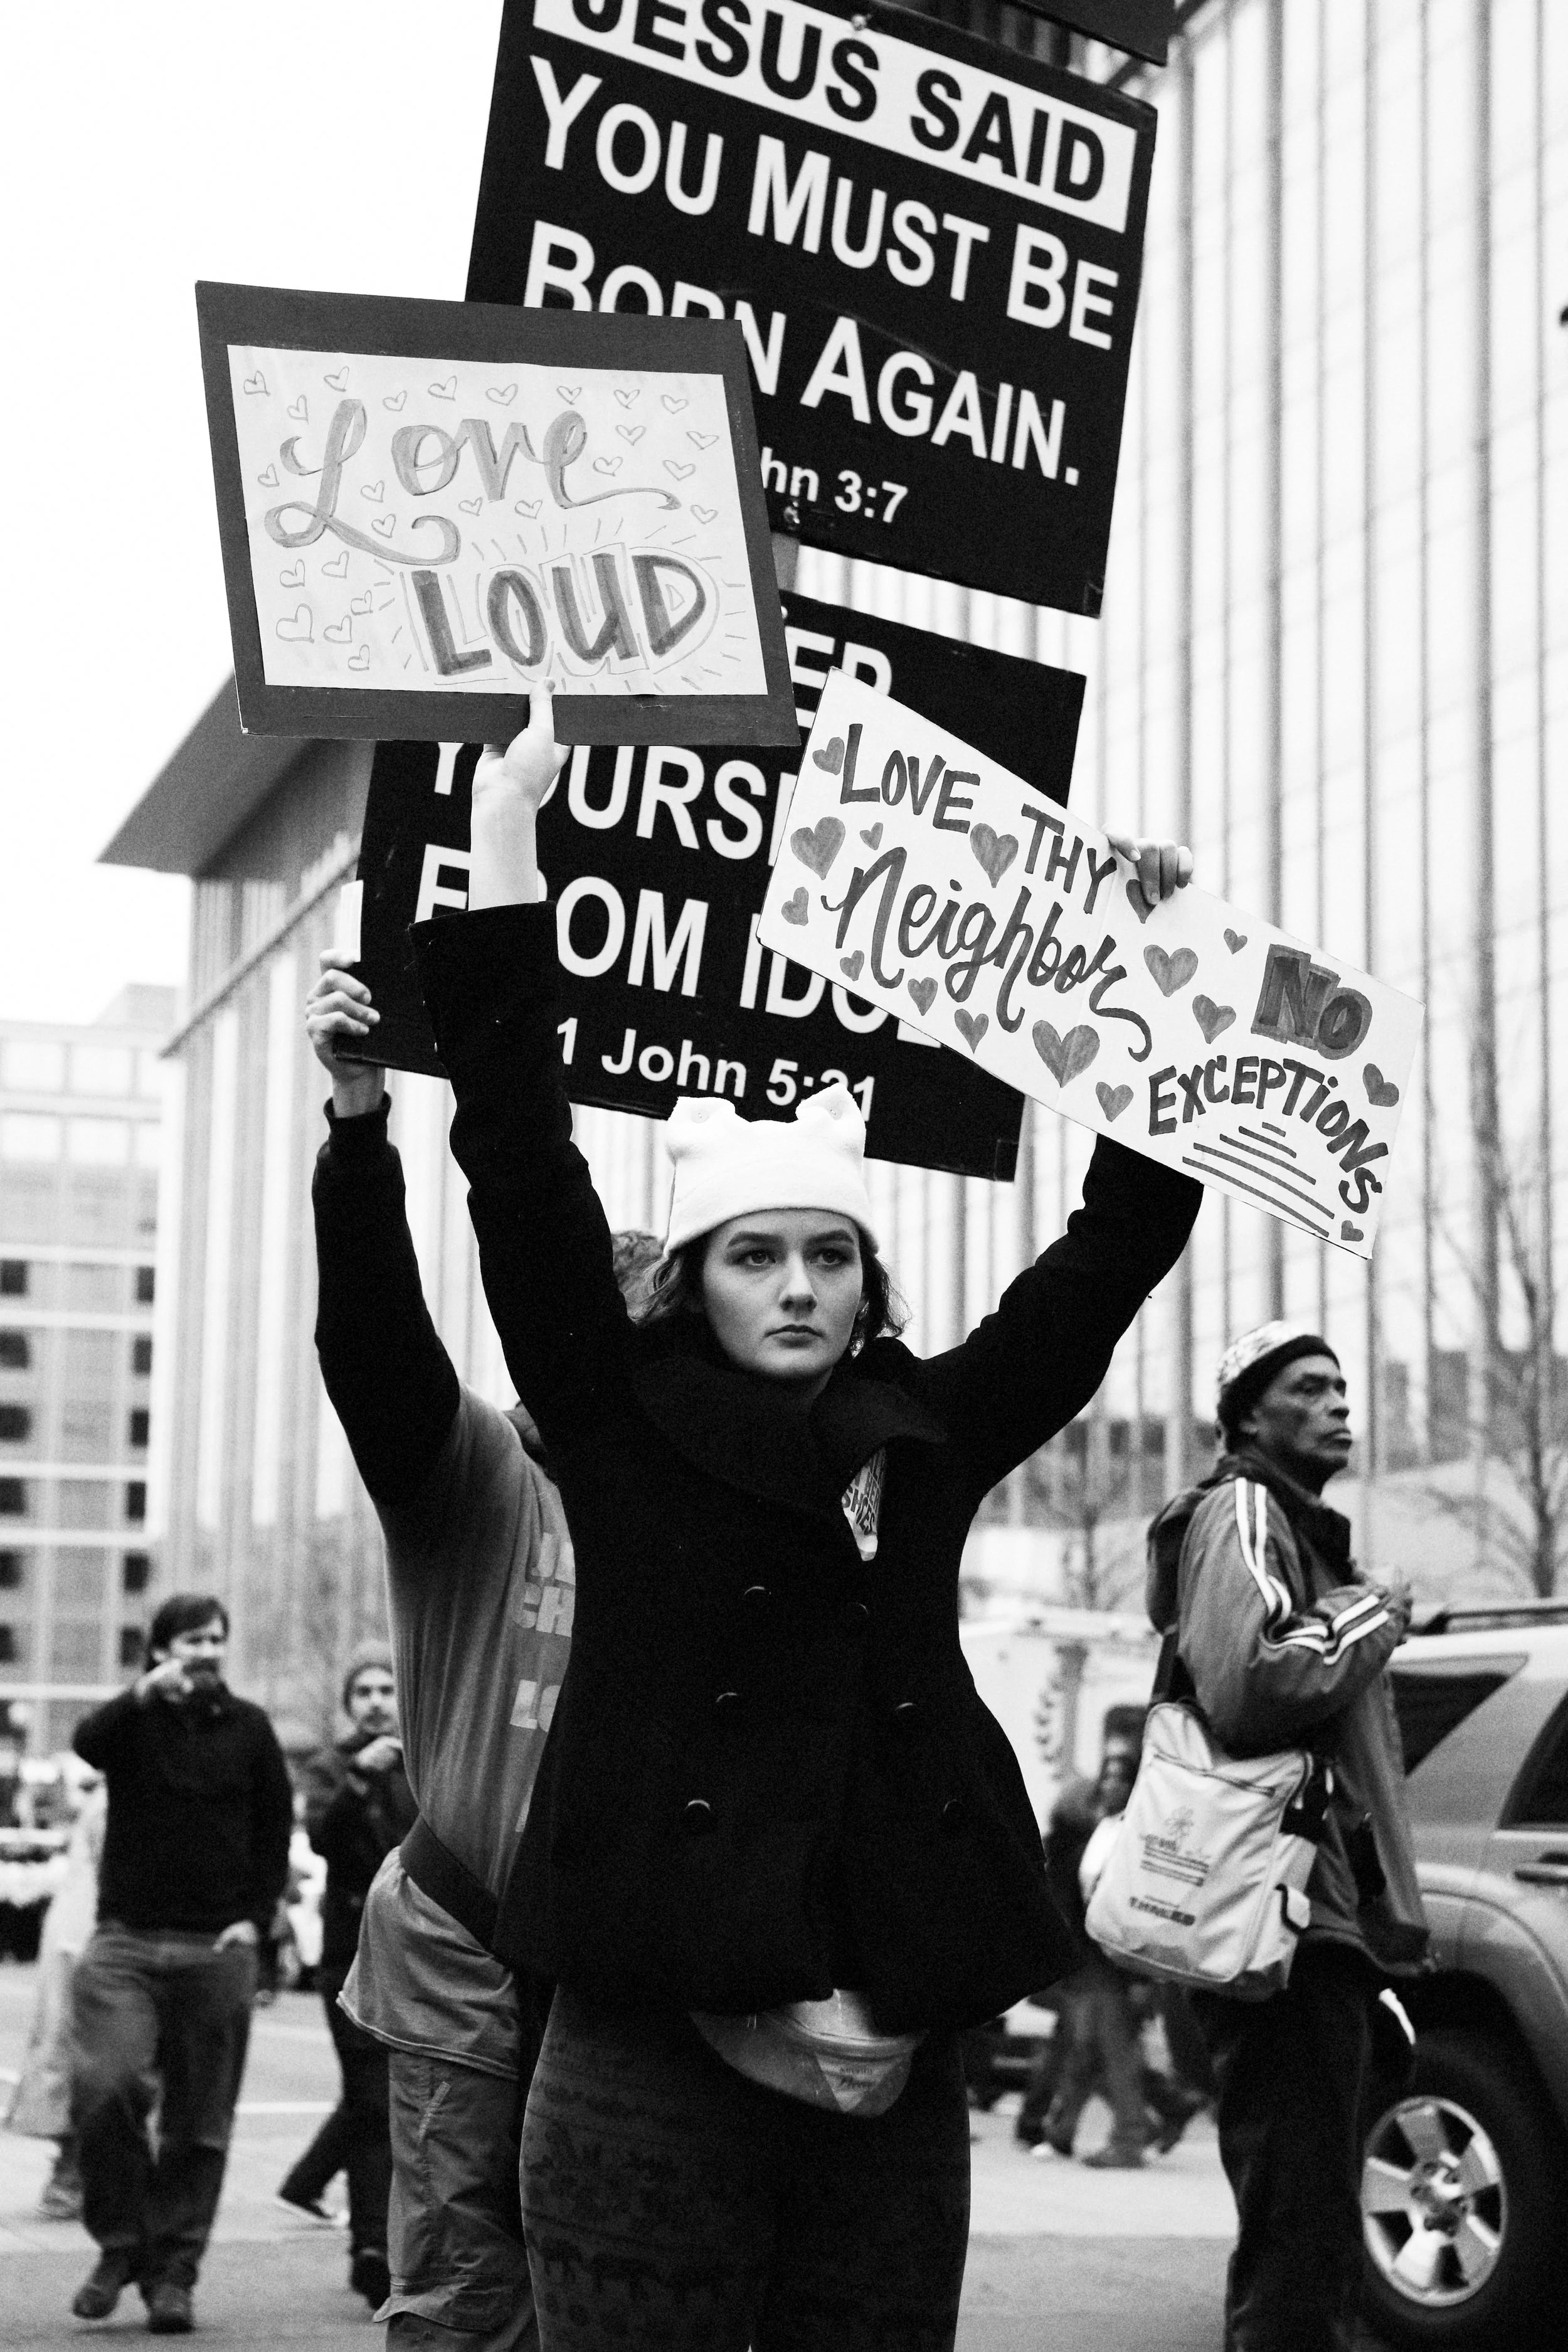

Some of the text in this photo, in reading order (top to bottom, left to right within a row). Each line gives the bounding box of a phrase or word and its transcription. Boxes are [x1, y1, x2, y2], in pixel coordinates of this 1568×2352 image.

[530, 55, 1119, 350] YOU MUST BE
[911, 69, 1104, 201] SAID
[801, 315, 1079, 485] AGAIN.
[264, 399, 681, 566] Love
[761, 446, 908, 523] hn 3:7
[409, 551, 707, 679] LOUD
[840, 724, 1117, 914] LOVE THY
[415, 844, 709, 997] FOM
[557, 1017, 578, 1064] 1
[601, 1029, 746, 1097] John
[1251, 944, 1372, 1060] NO
